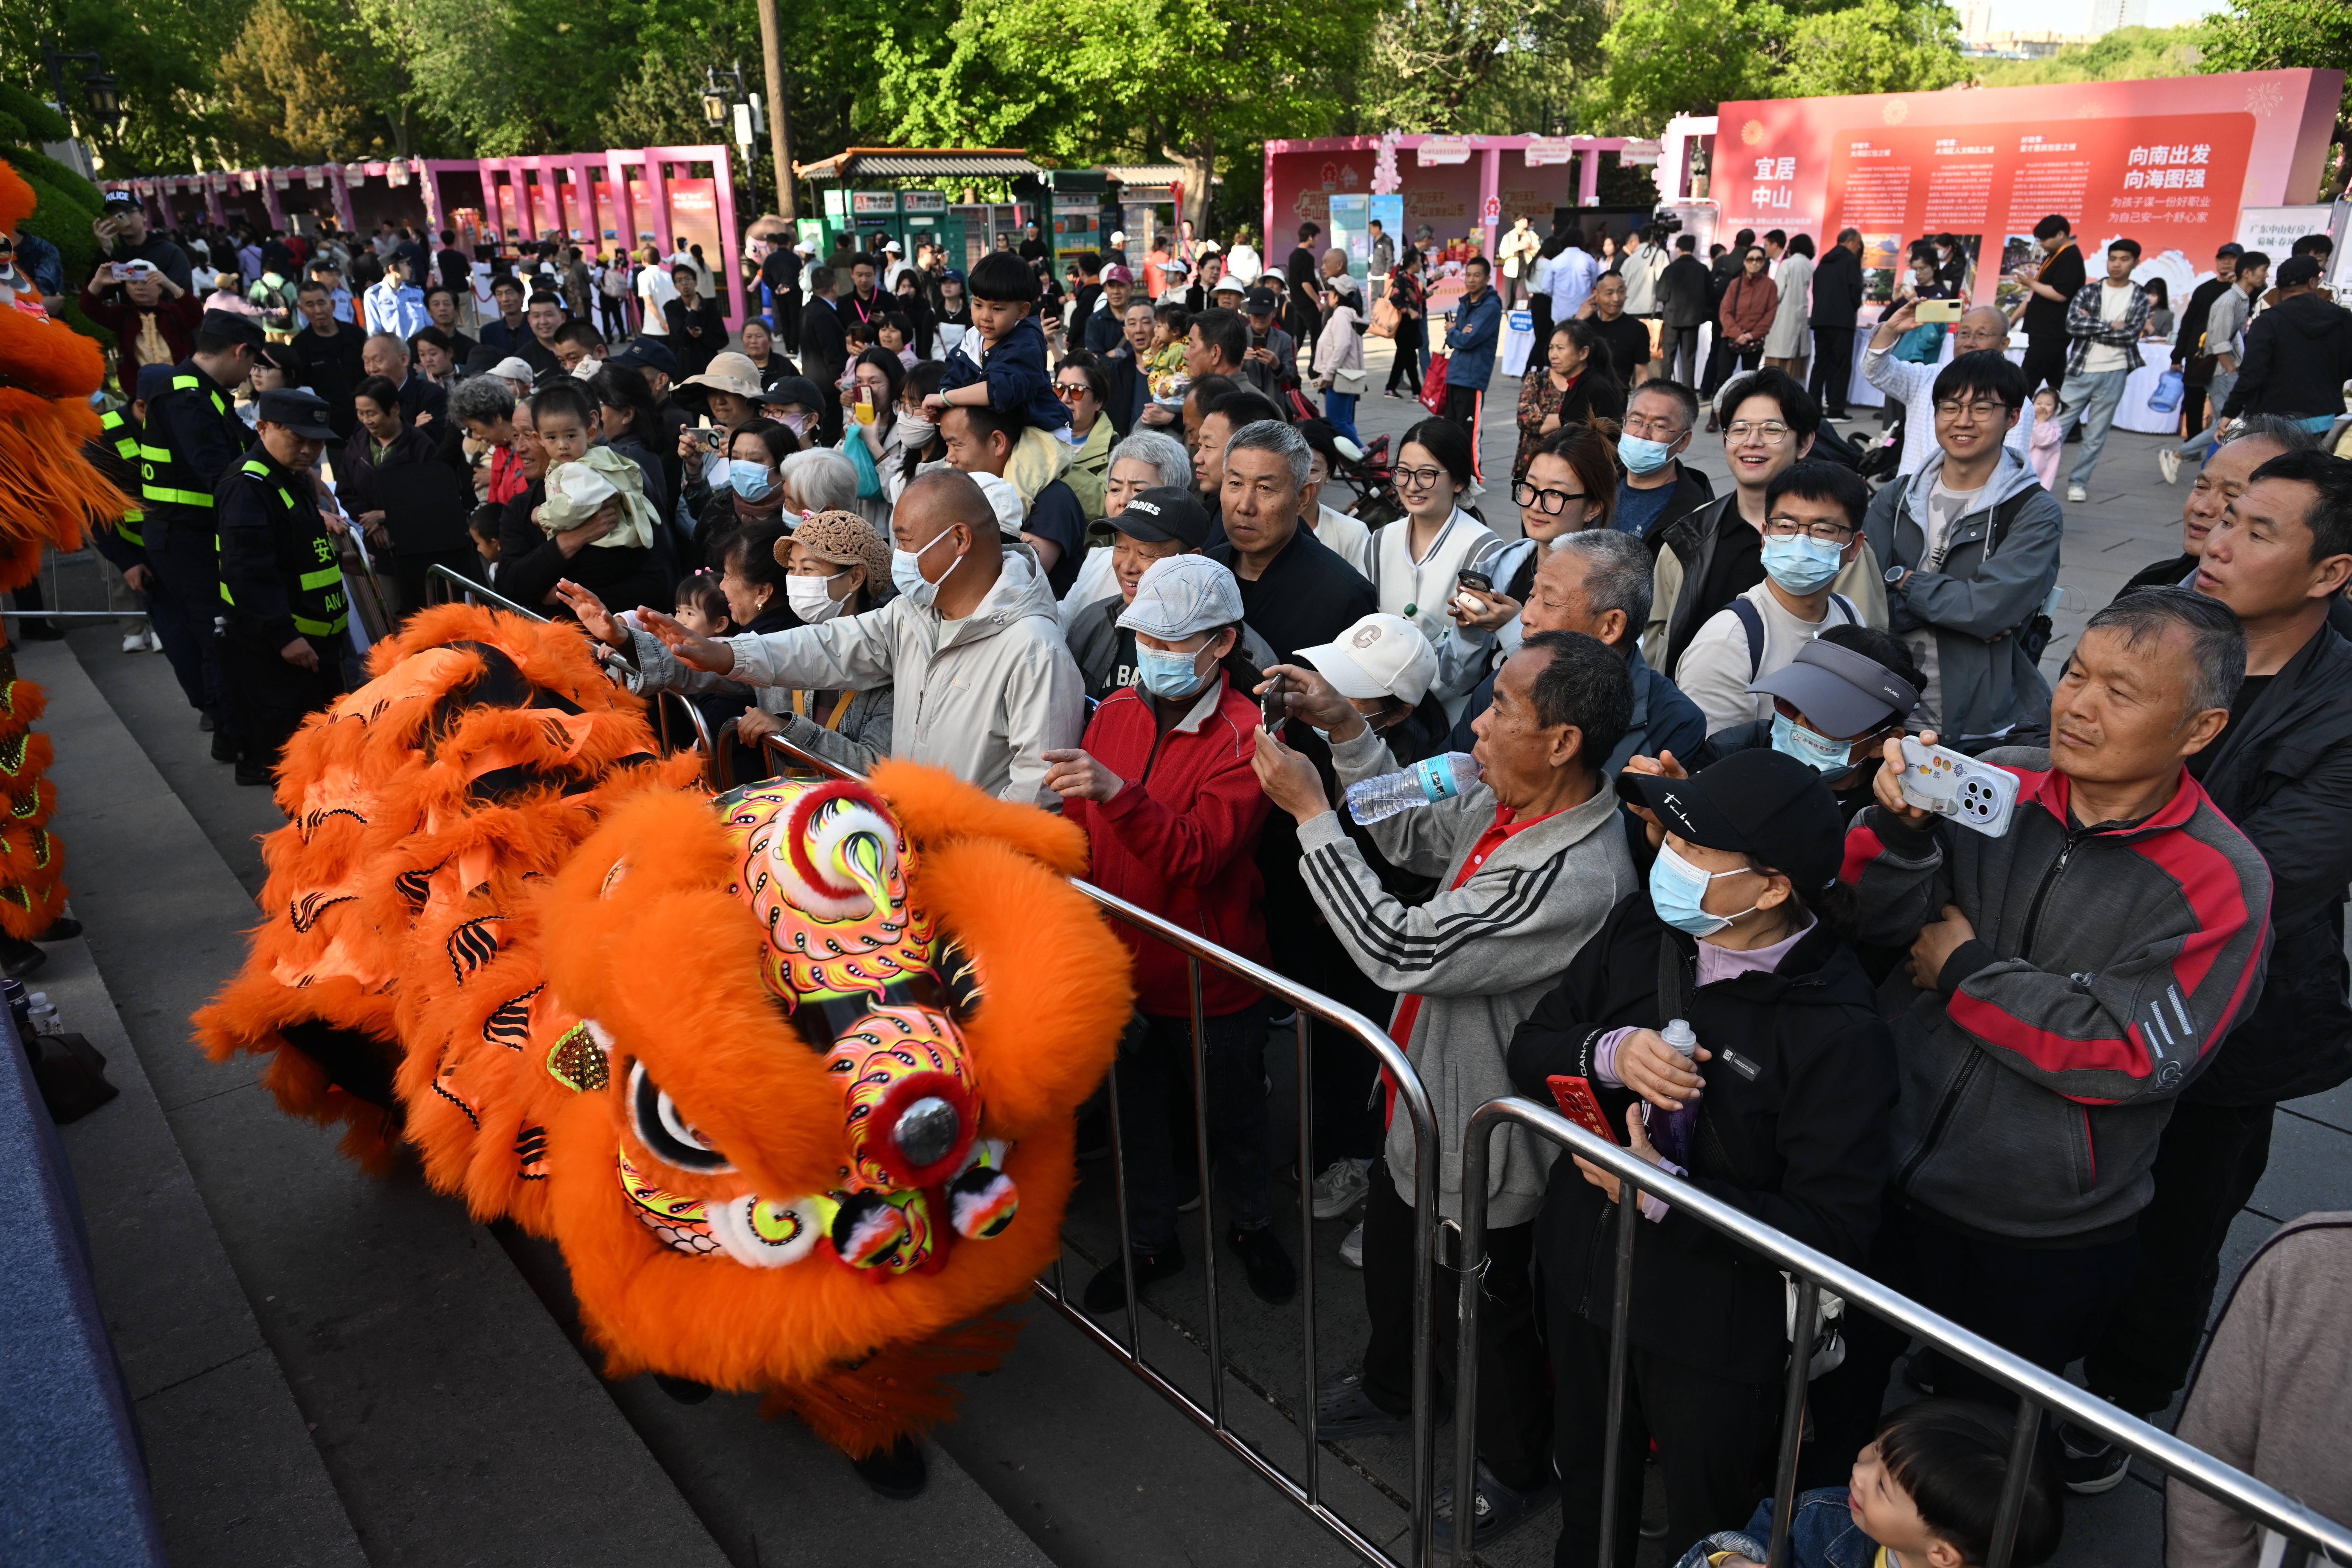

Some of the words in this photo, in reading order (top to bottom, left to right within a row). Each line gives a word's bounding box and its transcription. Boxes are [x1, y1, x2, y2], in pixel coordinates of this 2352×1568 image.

[2128, 144, 2211, 166] 向南出发
[1753, 157, 1796, 180] 宜居
[2123, 169, 2205, 190] 向海图强
[106, 191, 130, 203] POLICE
[1751, 185, 1792, 209] 中山
[2110, 196, 2211, 208] 为孩子谋一份好职业
[2108, 212, 2208, 223] 为自己安一个舒心家
[1351, 625, 1381, 649] C
[1803, 738, 1838, 754] 中国体育彩票
